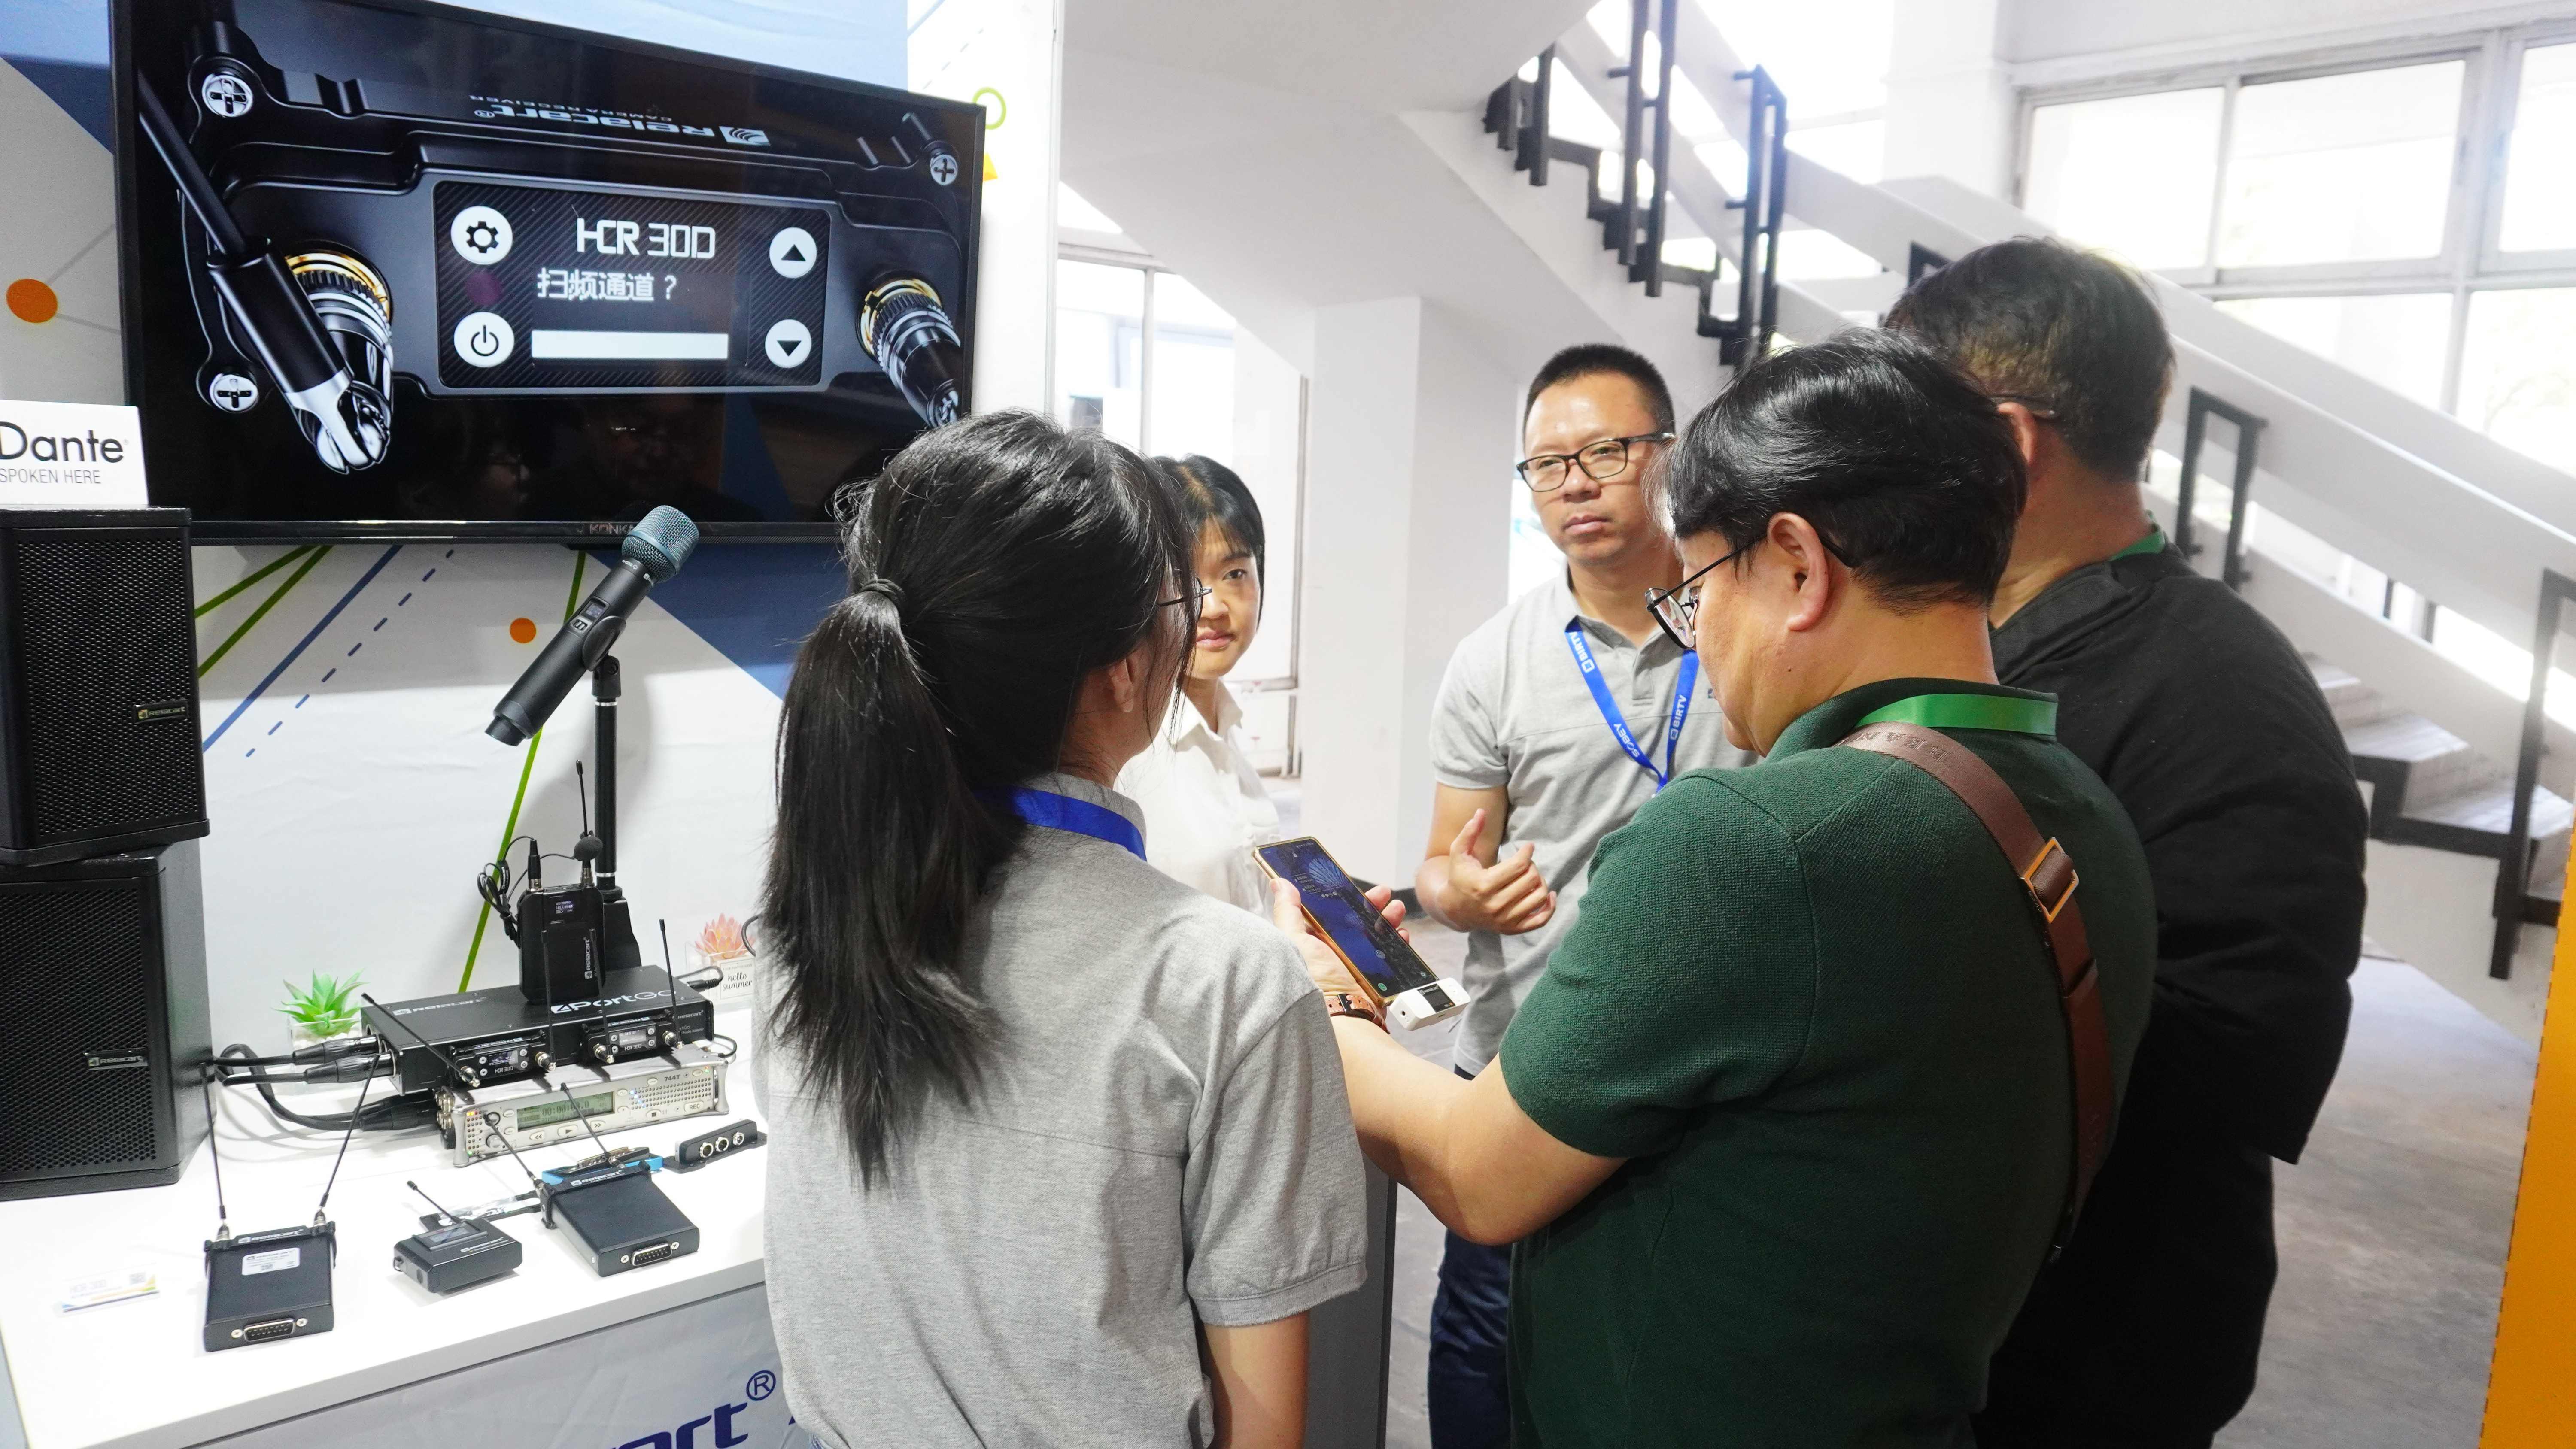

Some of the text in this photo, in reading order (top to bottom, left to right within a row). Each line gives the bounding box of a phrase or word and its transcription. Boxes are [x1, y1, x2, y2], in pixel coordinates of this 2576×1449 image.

[577, 217, 716, 259] HCR 30D
[0, 468, 102, 484] SPOKEN HERE
[1673, 694, 1687, 727] BIRTV
[1614, 723, 1640, 758] SOBEY
[723, 980, 752, 991] summer
[728, 971, 747, 982] hello
